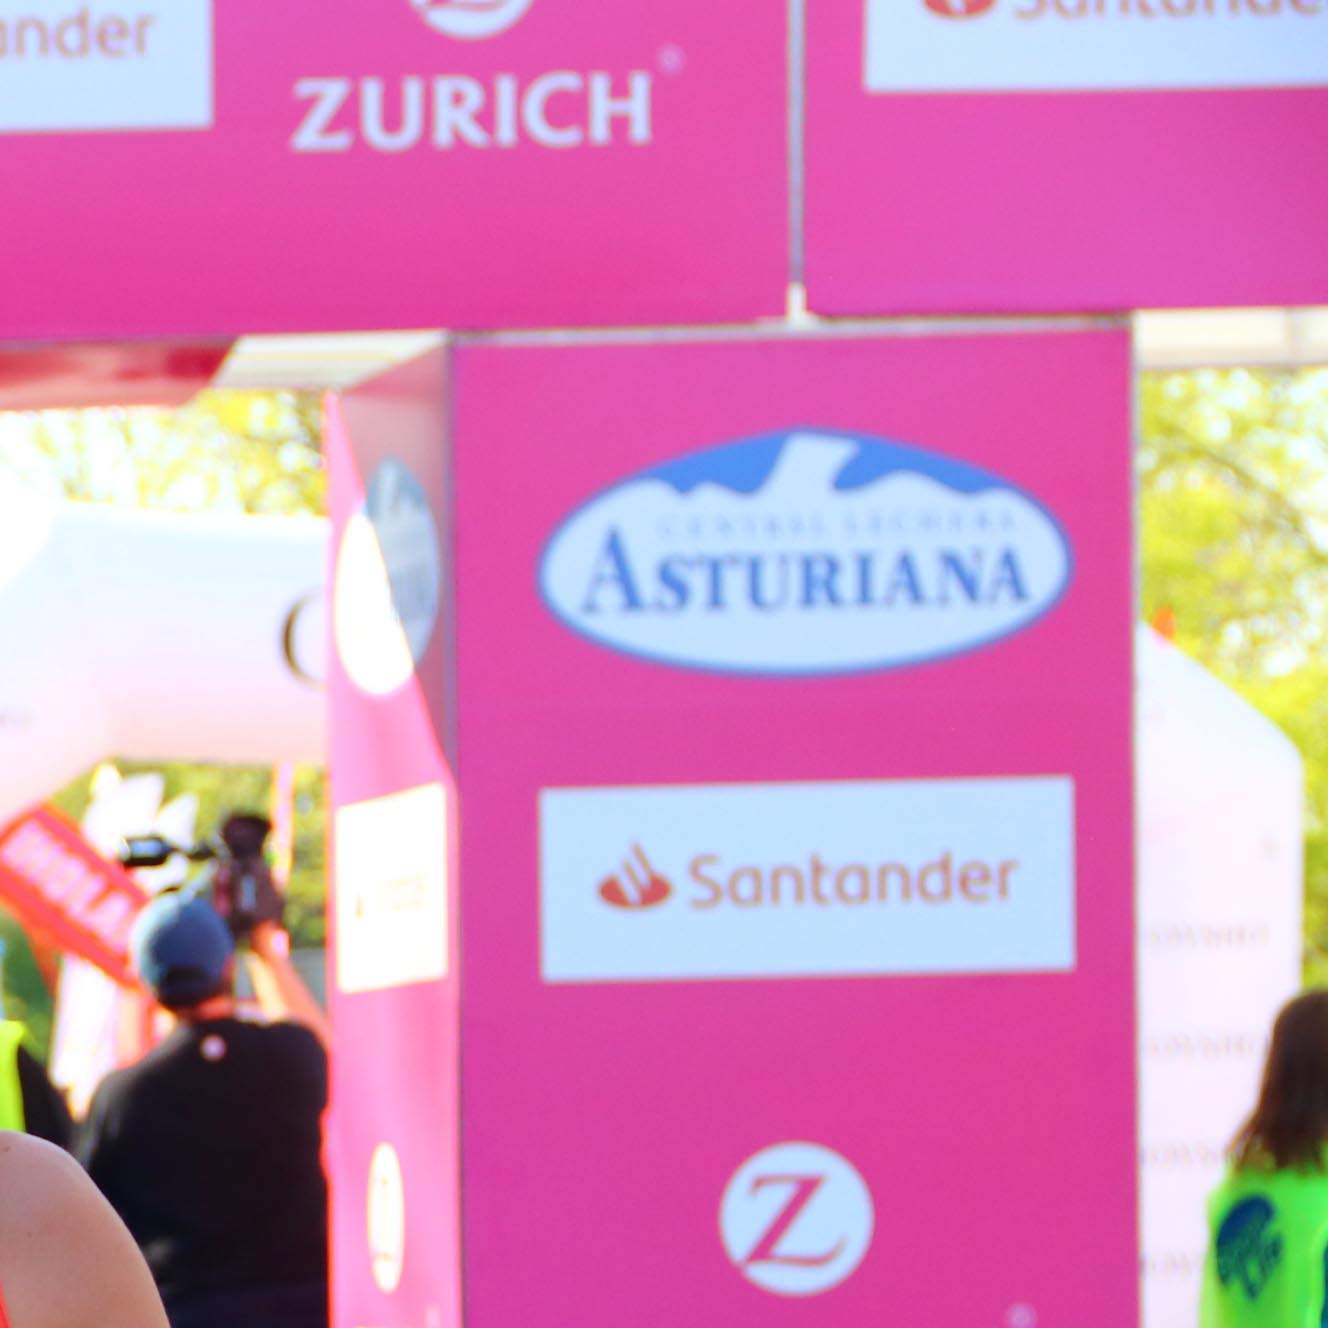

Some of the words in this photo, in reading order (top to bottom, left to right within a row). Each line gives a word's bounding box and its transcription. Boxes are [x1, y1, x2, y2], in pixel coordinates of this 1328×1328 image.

[290, 70, 653, 152] ZURICH
[580, 524, 1030, 613] ASTURIANA
[688, 849, 1019, 910] Santander
[748, 1173, 850, 1267] Z
